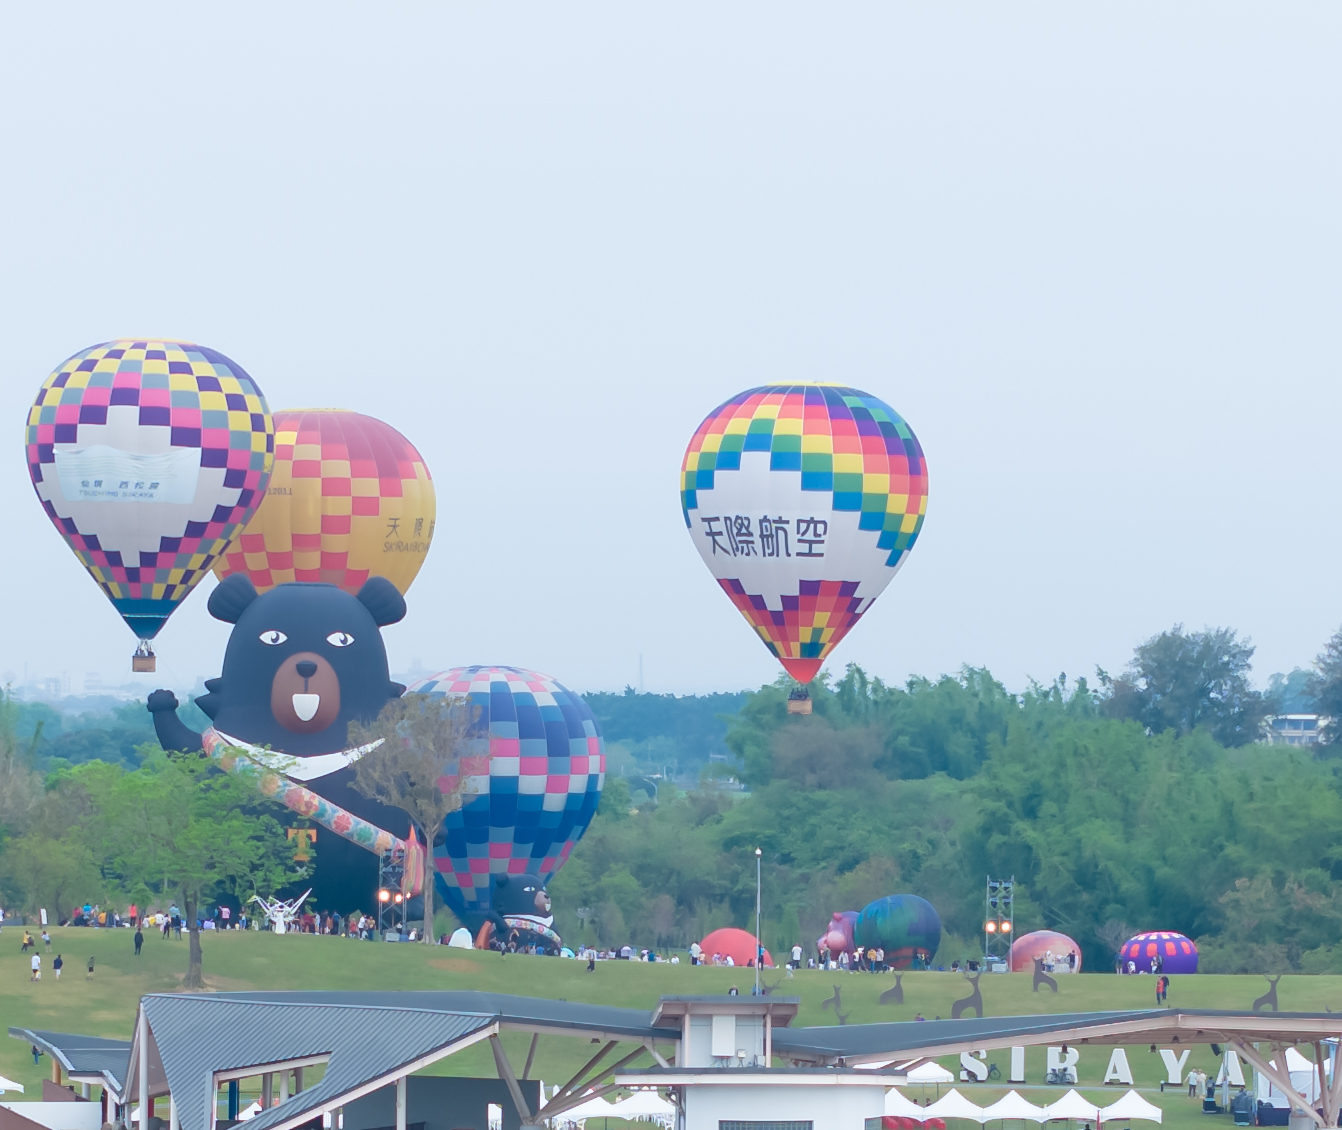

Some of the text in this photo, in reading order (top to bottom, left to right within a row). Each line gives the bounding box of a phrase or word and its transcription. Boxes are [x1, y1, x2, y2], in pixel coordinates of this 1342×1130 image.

[700, 515, 828, 558] 天際航空
[960, 1046, 1246, 1086] SIRAYA
